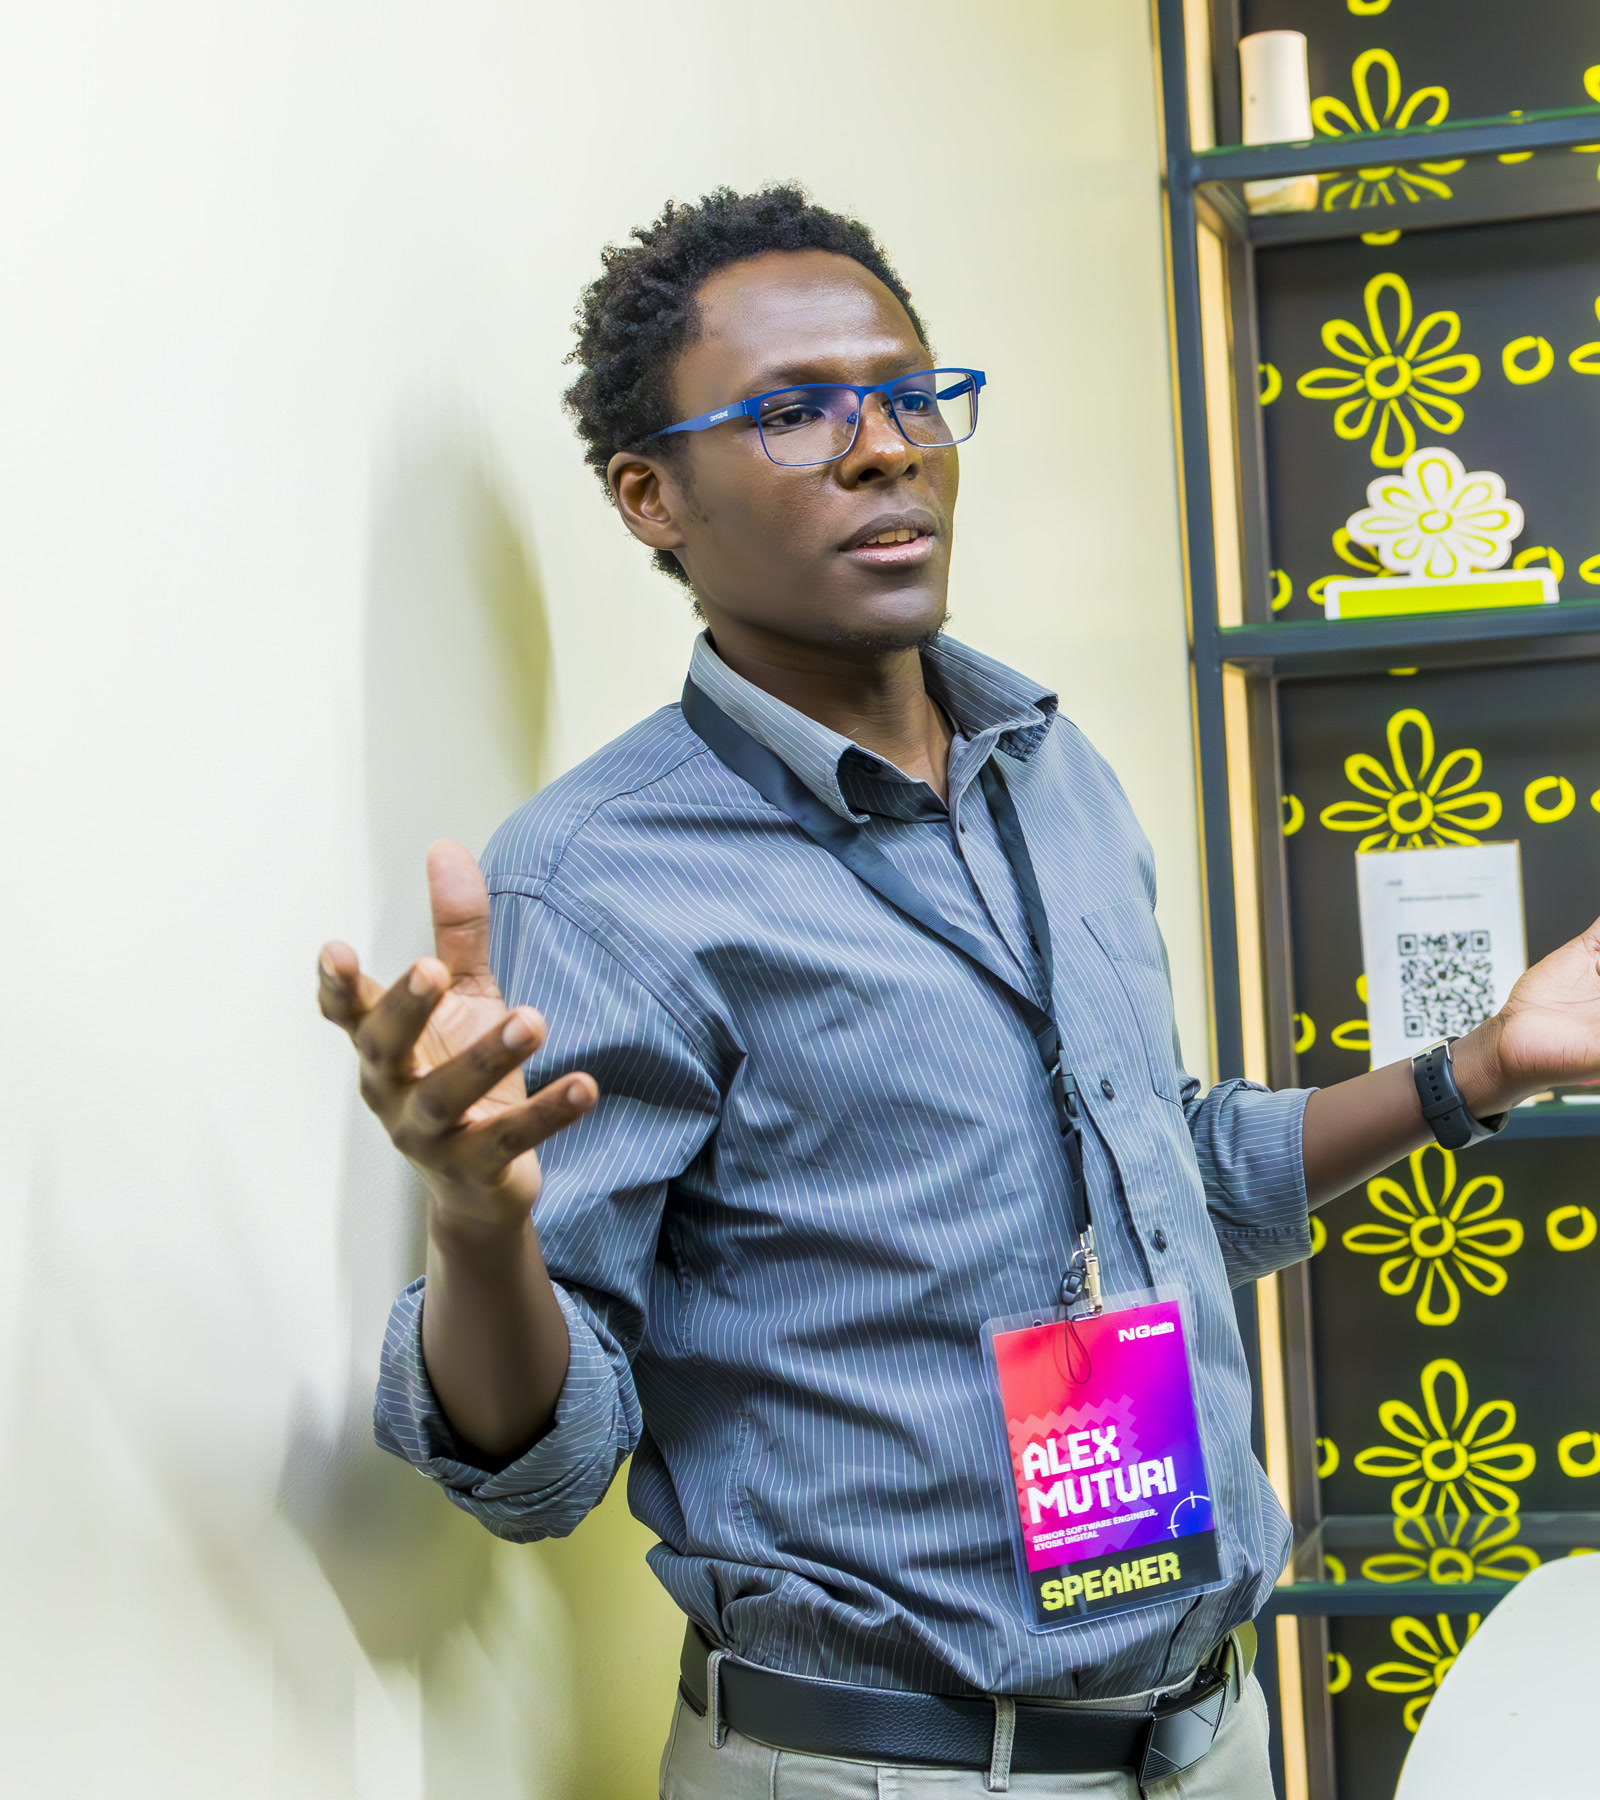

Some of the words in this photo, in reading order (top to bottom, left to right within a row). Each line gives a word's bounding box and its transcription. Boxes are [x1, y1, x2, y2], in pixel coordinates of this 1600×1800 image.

[1021, 1425, 1119, 1480] ALEX
[1027, 1456, 1177, 1523] MUTURI
[1032, 1529, 1065, 1543] SENIOR
[1065, 1518, 1113, 1535] SOFTWARE
[1112, 1508, 1159, 1525] ENGINEER,
[1033, 1538, 1065, 1551] KYOSK
[1064, 1530, 1100, 1544] DIGITAL
[1040, 1552, 1181, 1611] SPEAKER
